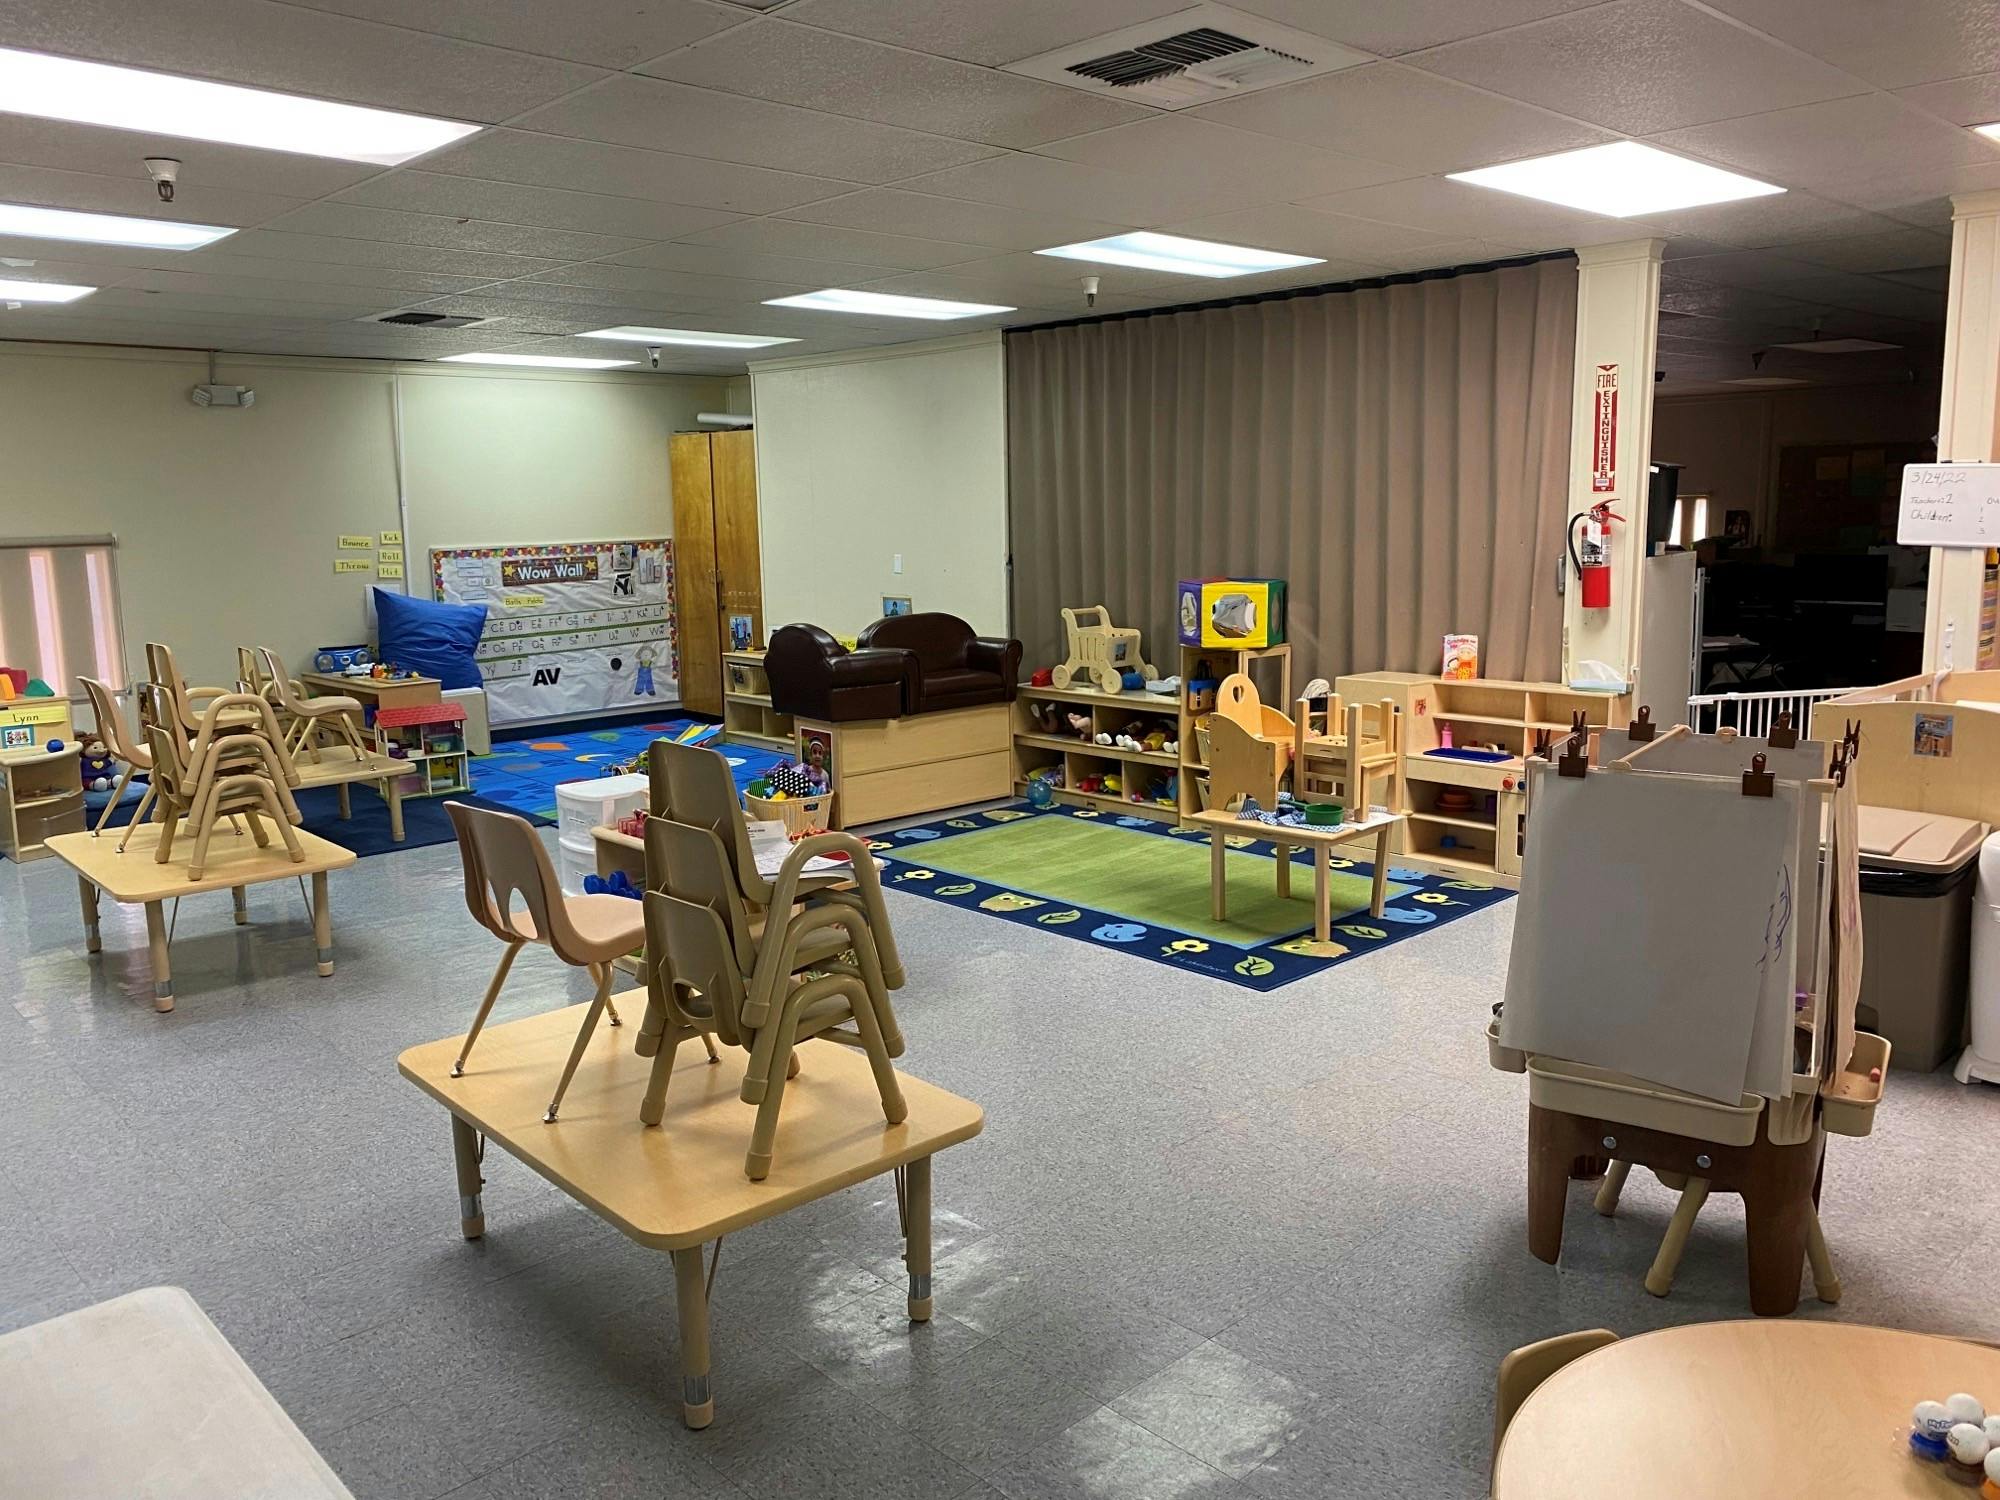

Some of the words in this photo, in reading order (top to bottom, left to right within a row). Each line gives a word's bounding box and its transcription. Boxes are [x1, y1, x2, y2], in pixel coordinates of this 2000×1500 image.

[1597, 374, 1617, 388] FIRE
[1600, 391, 1610, 478] EXTINGUISHER
[1911, 470, 1967, 487] 3/24/22
[342, 538, 369, 548] Bounce
[382, 552, 399, 561] Roll
[340, 562, 369, 570] Throw
[382, 567, 398, 576] Hit
[517, 565, 551, 580] Wow
[554, 563, 583, 577] Wall
[532, 667, 561, 687] AV
[12, 713, 39, 725] Lynn
